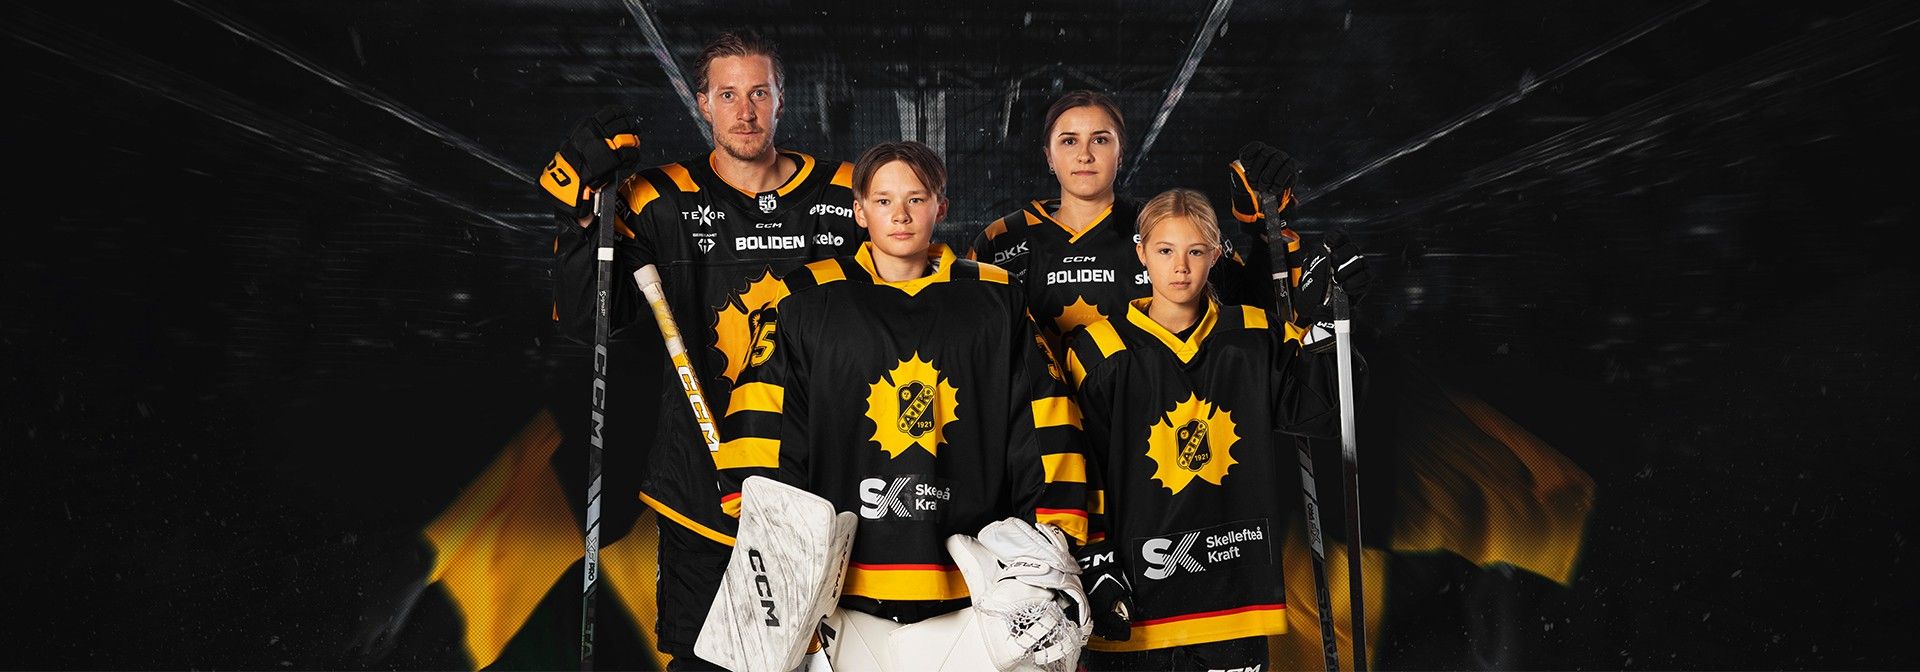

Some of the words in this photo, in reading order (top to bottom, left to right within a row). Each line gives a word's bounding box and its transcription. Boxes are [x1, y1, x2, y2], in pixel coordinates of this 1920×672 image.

[735, 235, 805, 251] BOLIDEN
[1047, 269, 1115, 285] BOLIDEN
[590, 344, 607, 450] CCM
[678, 366, 720, 451] CCM
[1194, 453, 1209, 461] 1921
[1205, 526, 1263, 548] Skellefteå
[1207, 546, 1241, 563] Kraft
[748, 549, 780, 627] CCM
